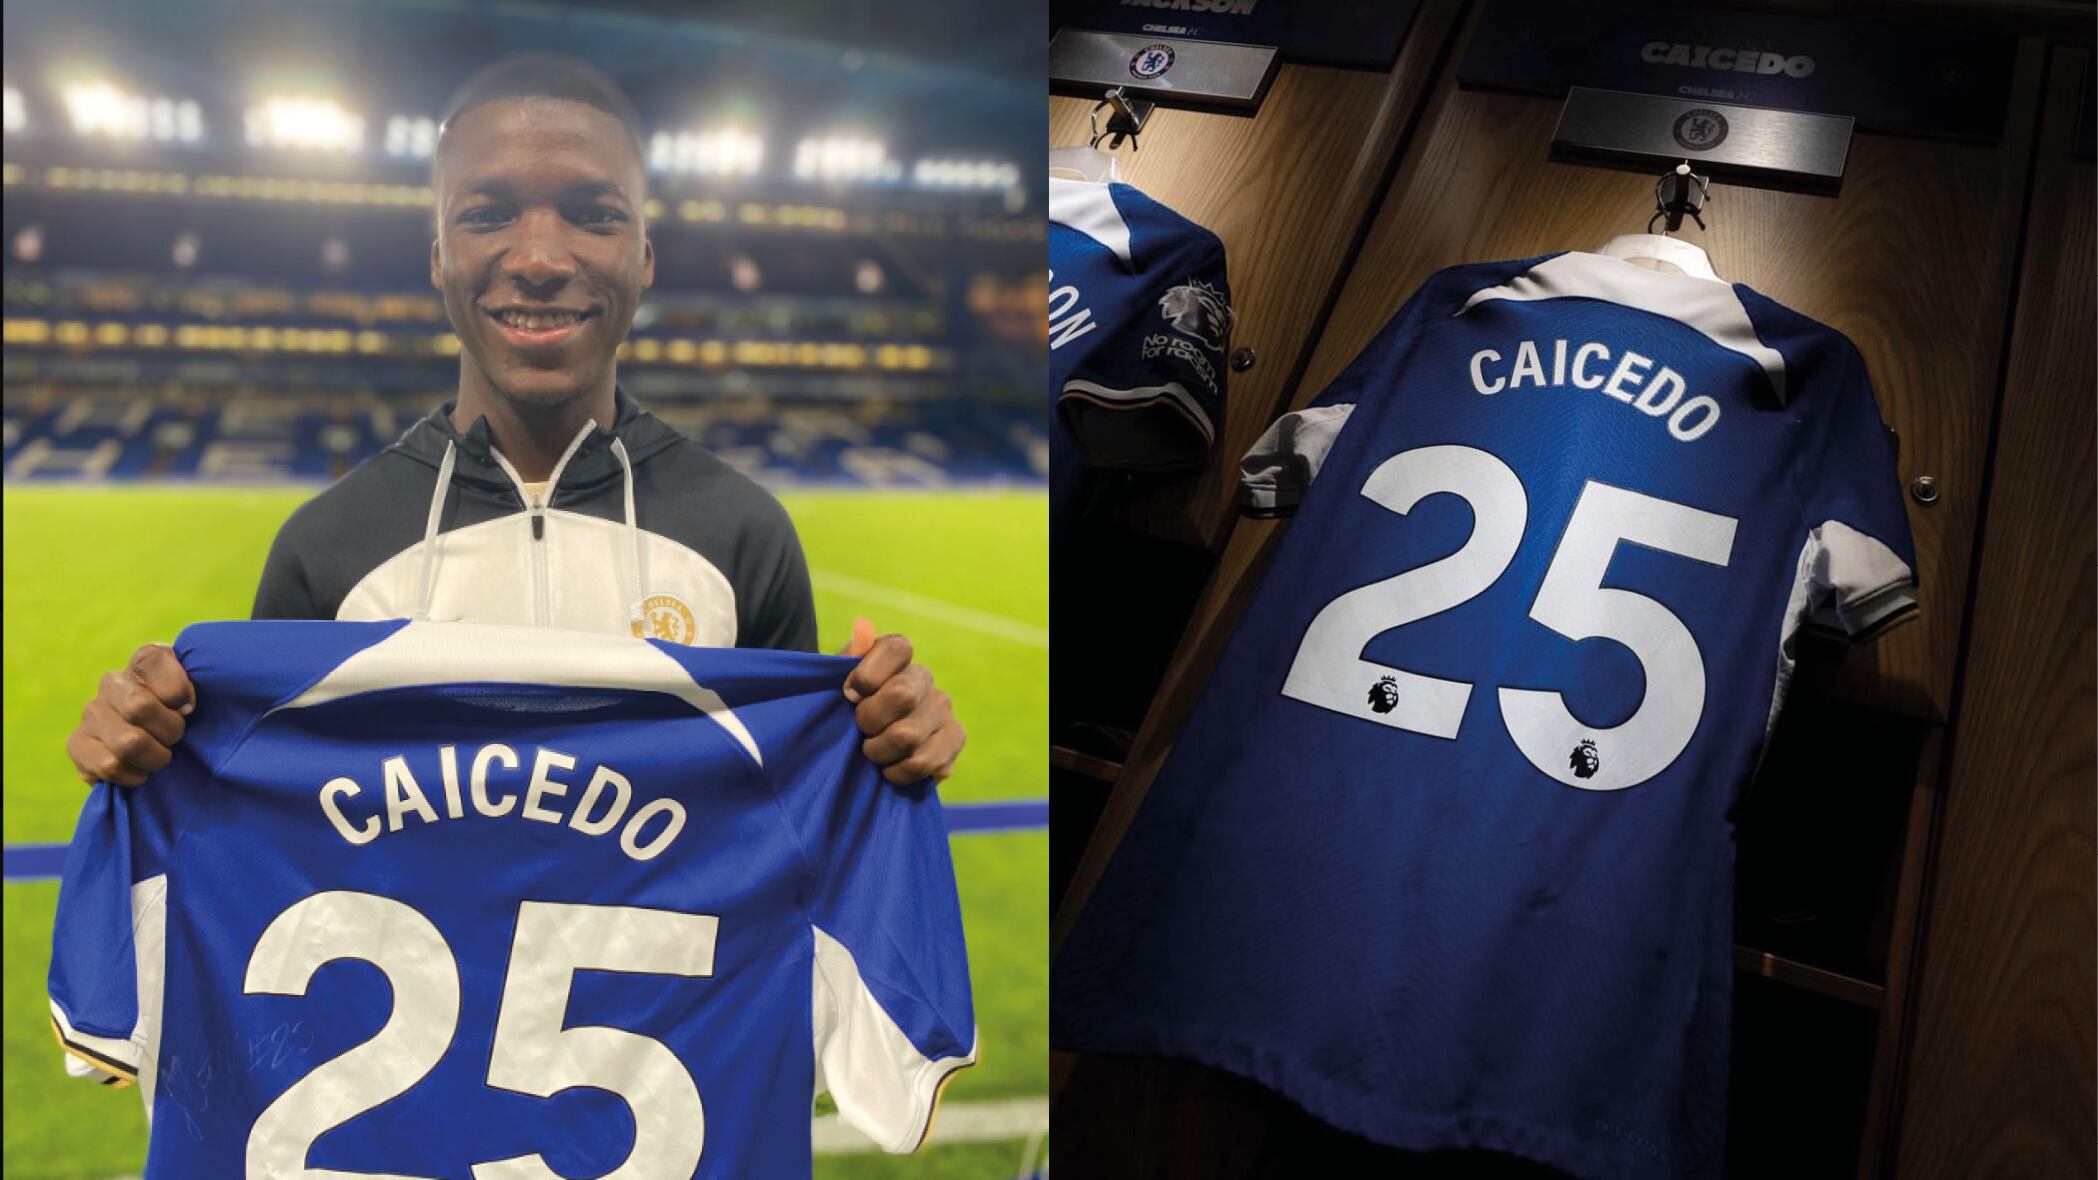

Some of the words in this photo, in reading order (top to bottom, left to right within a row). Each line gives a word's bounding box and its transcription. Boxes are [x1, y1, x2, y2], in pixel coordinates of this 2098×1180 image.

[1142, 24, 1186, 34] CHELSEA
[1641, 41, 1816, 78] CAICEDO
[1678, 86, 1735, 99] CHELSEA
[1143, 333, 1168, 348] No
[1470, 339, 1721, 442] CAICEDO
[1281, 444, 1739, 791] 25
[319, 743, 688, 861] CAICEDO
[242, 889, 720, 1180] 25
